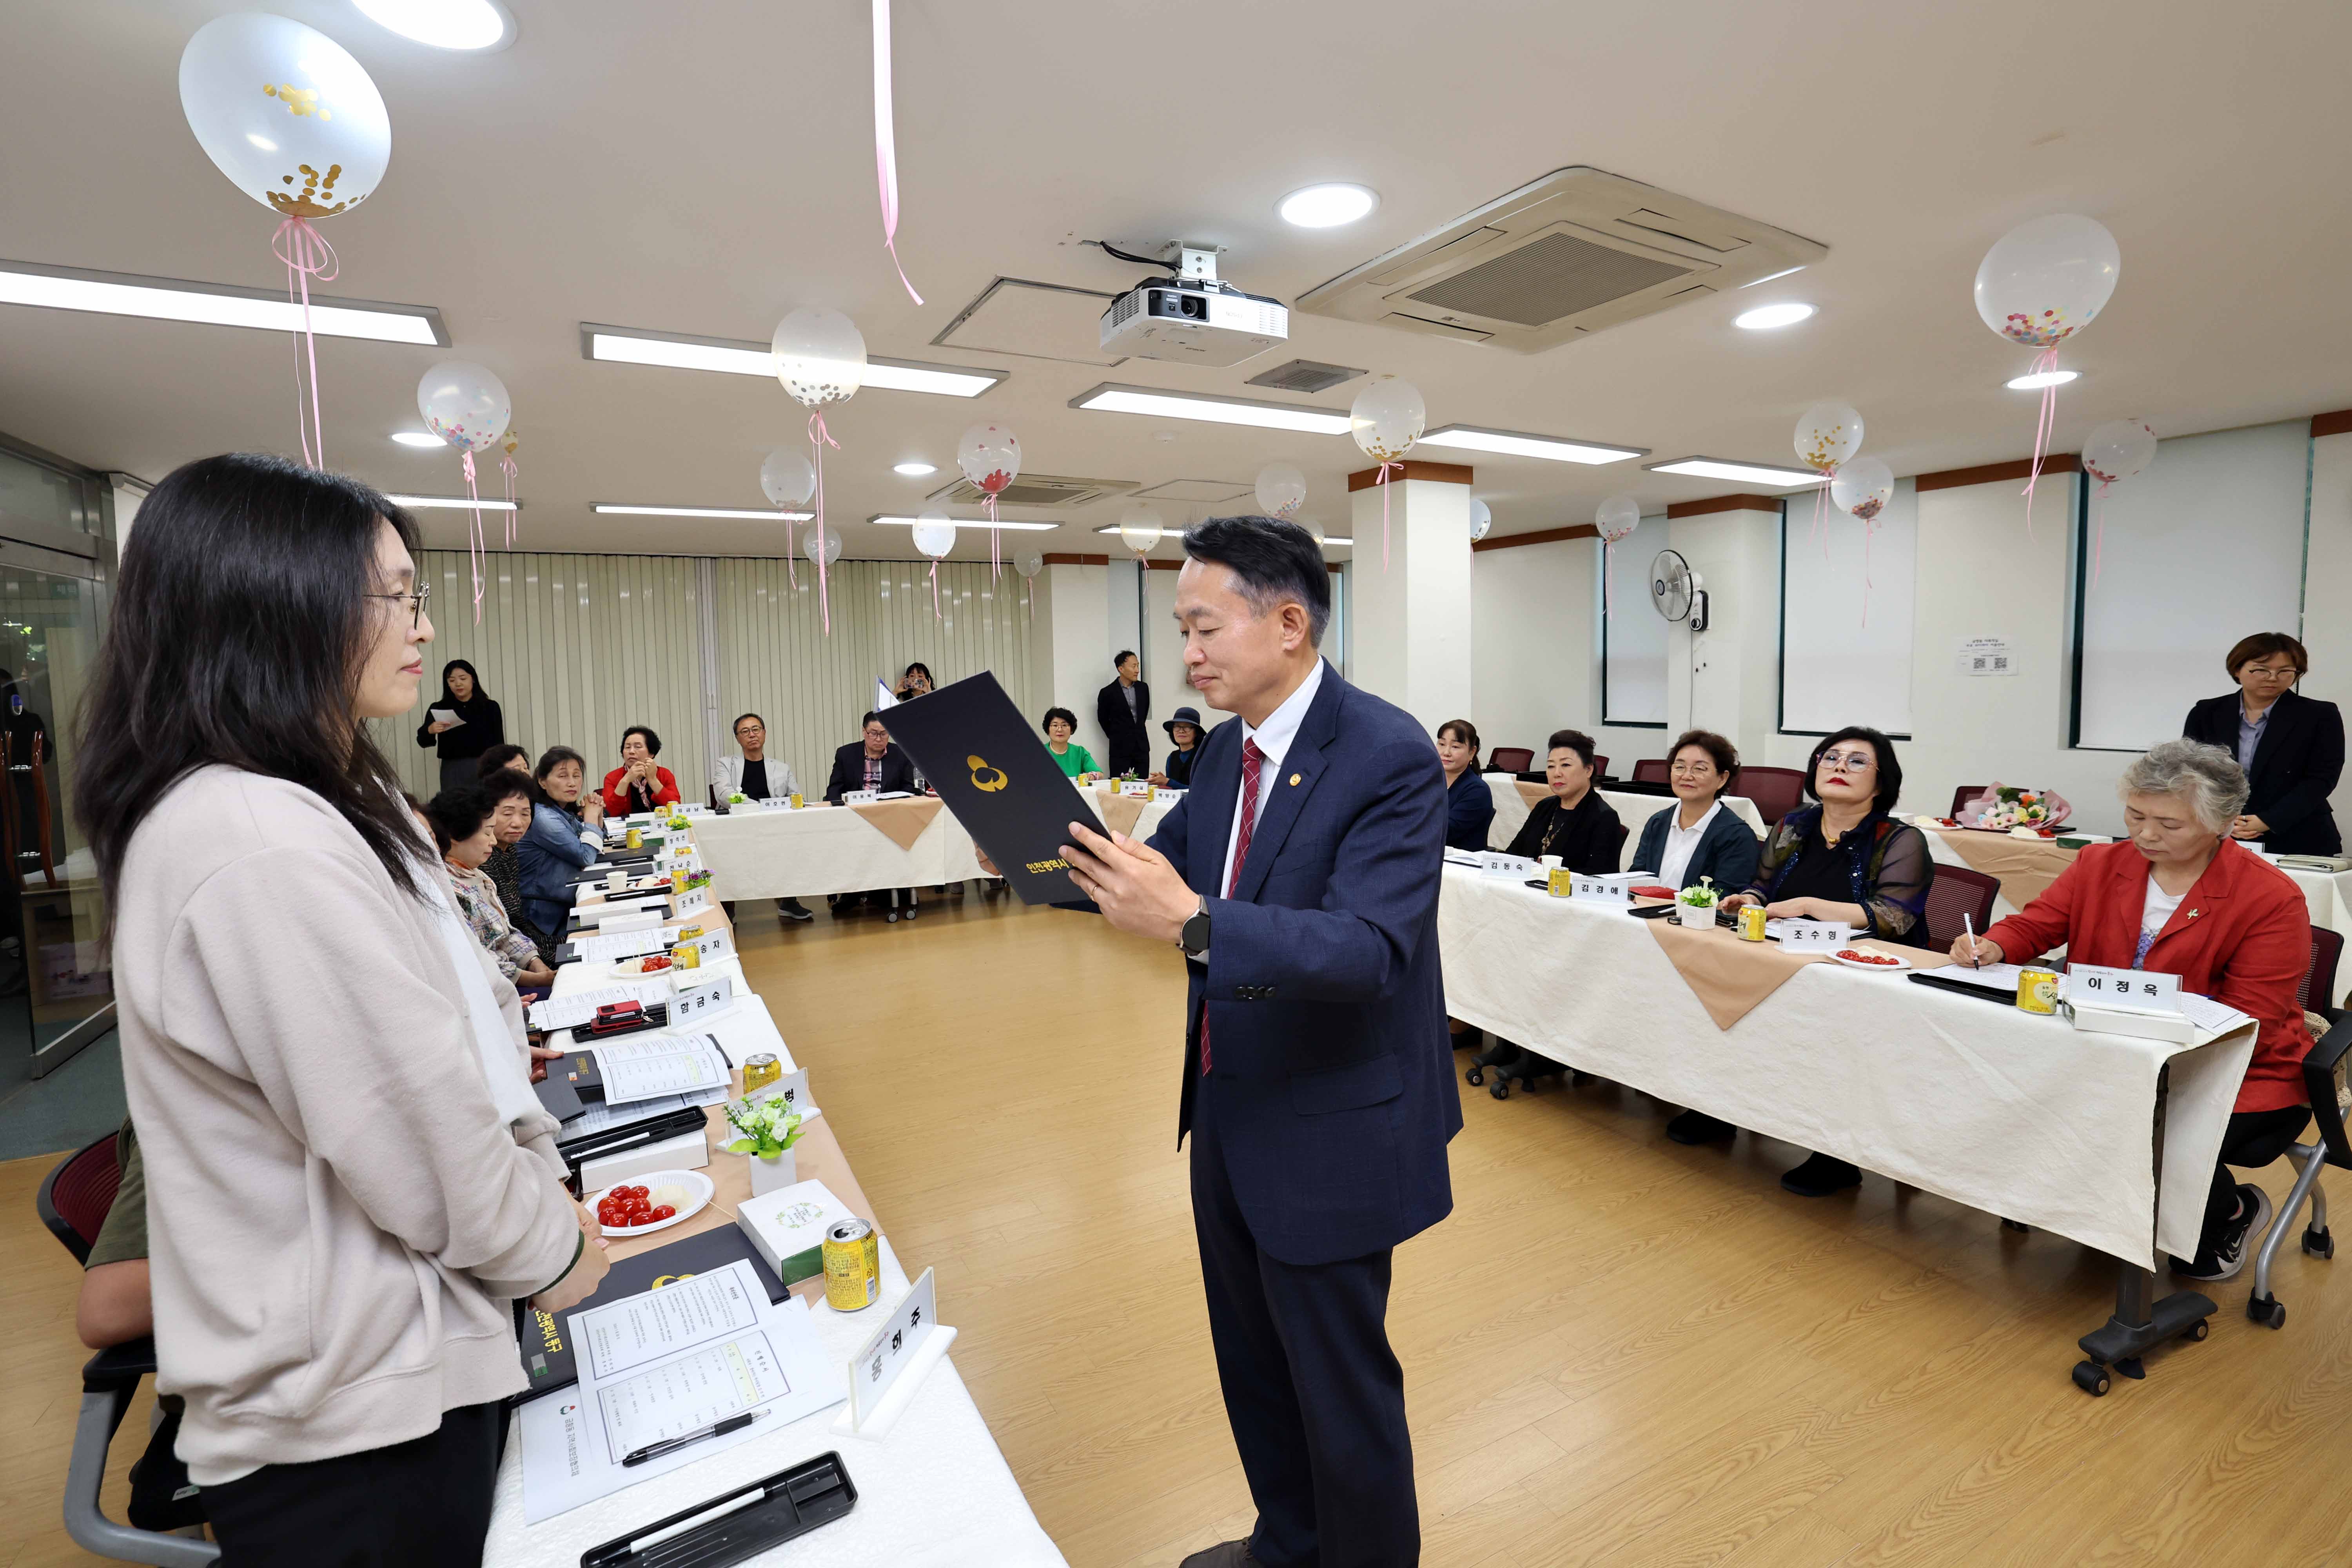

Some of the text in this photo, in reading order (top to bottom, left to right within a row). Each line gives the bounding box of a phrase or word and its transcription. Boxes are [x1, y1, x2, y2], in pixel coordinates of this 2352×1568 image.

[1026, 858, 1069, 874] 인천광역시
[701, 940, 720, 954] 송자
[545, 1337, 563, 1353] 동구
